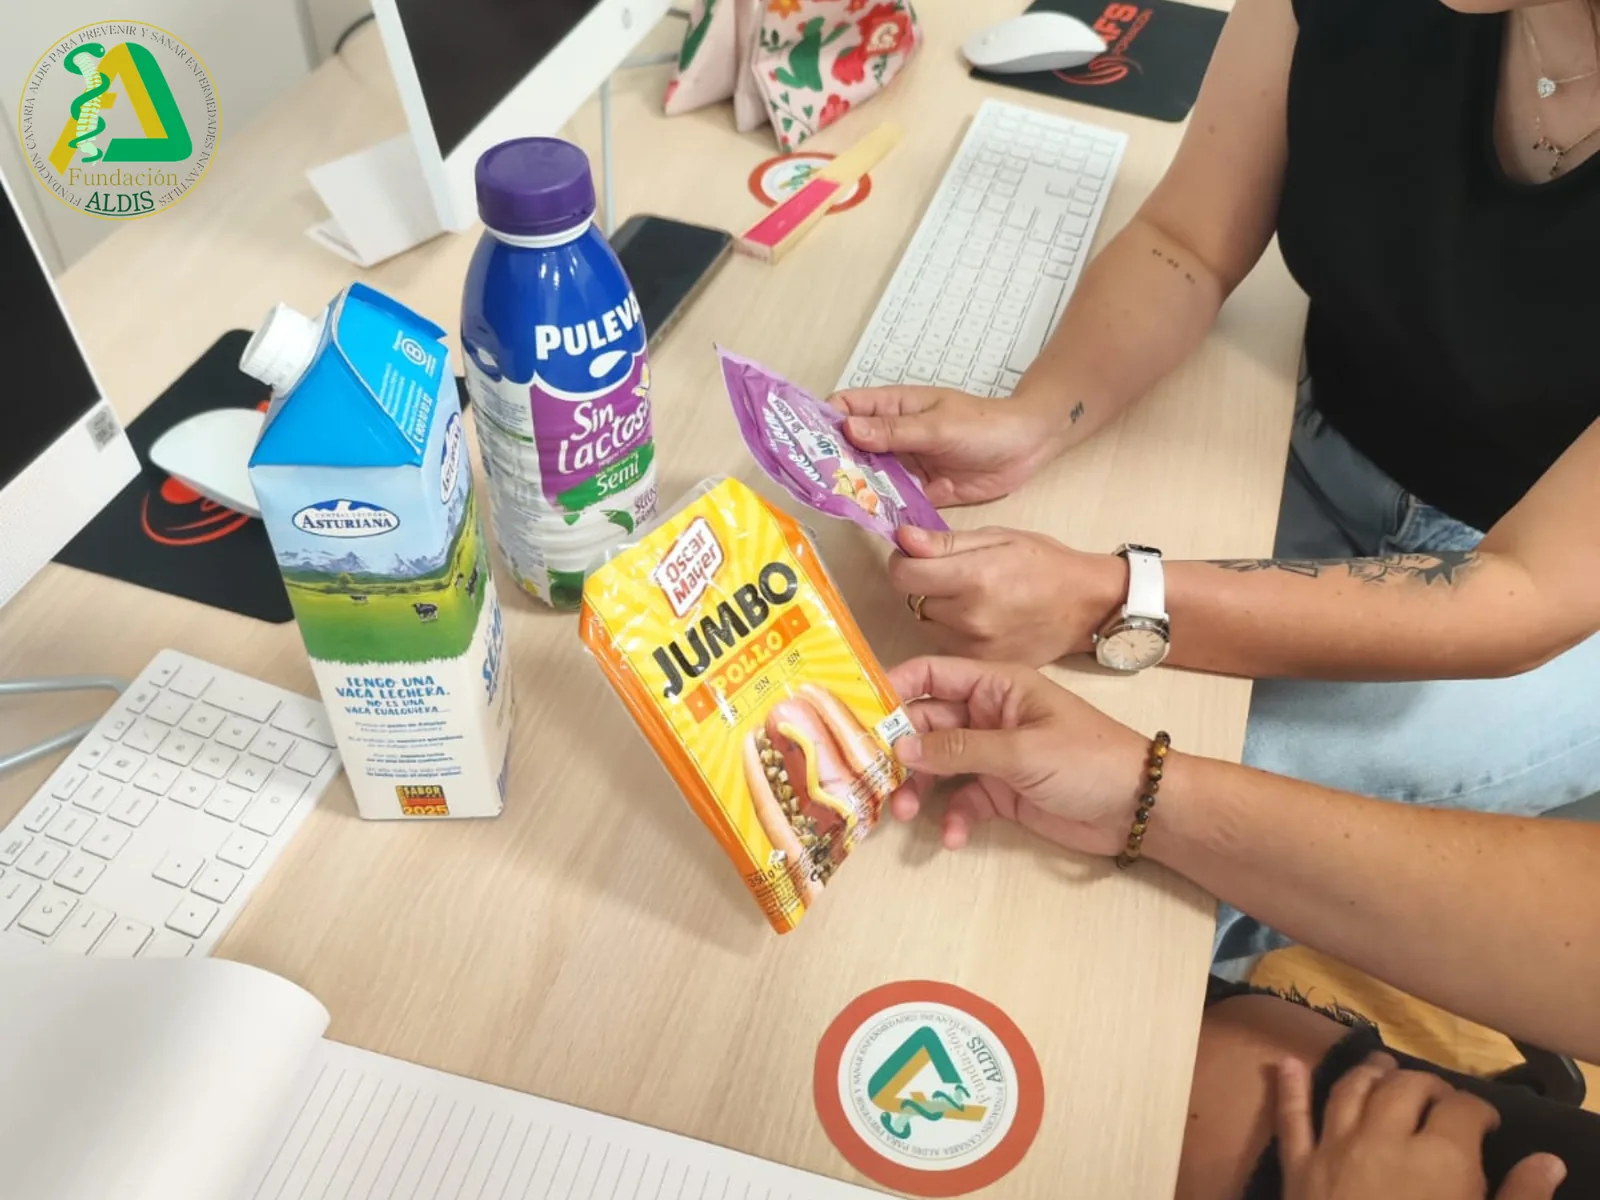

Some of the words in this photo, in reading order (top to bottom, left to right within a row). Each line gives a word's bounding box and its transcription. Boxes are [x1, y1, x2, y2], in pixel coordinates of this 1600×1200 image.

[571, 401, 614, 441] Sin
[596, 453, 640, 496] Semi
[302, 513, 393, 530] ASTURIANA
[665, 529, 706, 582] Oscar
[673, 544, 717, 605] Mayer
[652, 562, 798, 699] JUMBO
[346, 676, 396, 688] TENGO
[401, 675, 435, 687] UNA
[713, 630, 783, 693] POLLO
[754, 676, 770, 693] SIN
[787, 650, 801, 667] SIN
[335, 687, 374, 699] VACA
[344, 706, 372, 715] VACA
[366, 700, 381, 708] NO
[386, 700, 399, 708] ES
[403, 698, 425, 707] UNA
[403, 805, 448, 816] 2025
[966, 1036, 1003, 1083] ALDIS
